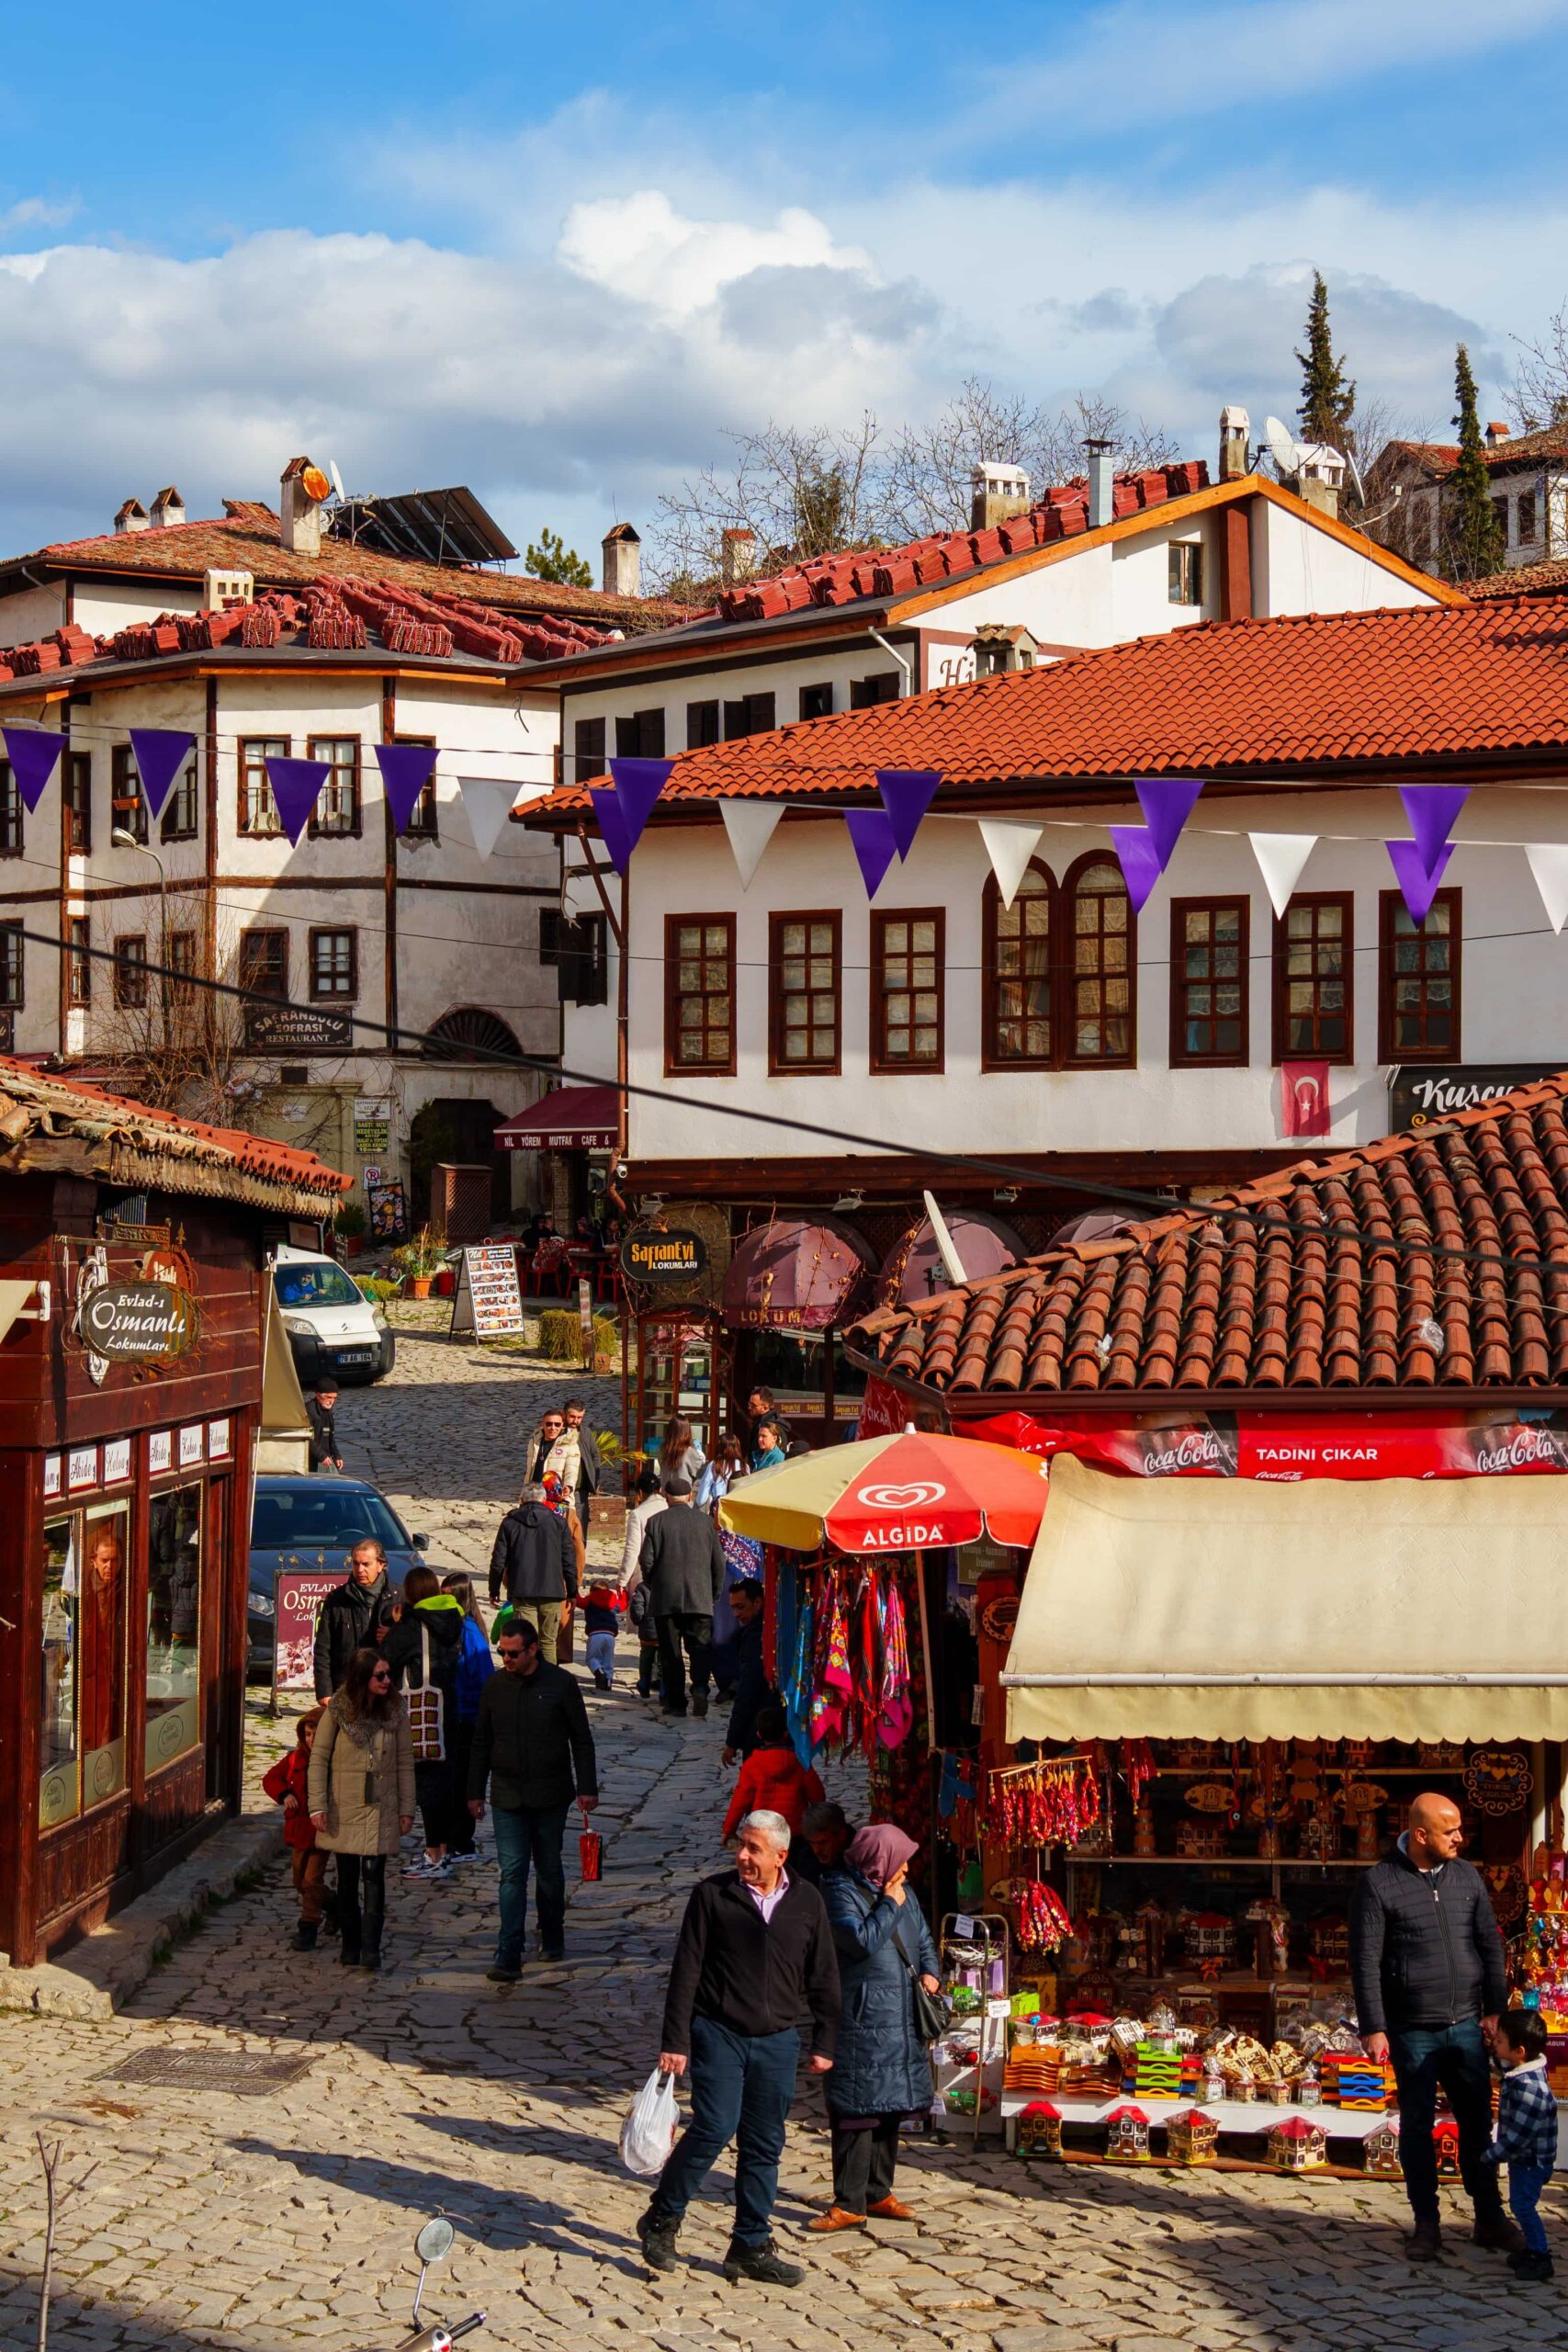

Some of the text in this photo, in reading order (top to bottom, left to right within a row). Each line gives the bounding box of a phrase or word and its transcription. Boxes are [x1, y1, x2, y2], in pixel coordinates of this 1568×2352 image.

[265, 1034, 330, 1043] RESTAURANT
[521, 1135, 541, 1147] YÖREM
[548, 1136, 572, 1146] MUTFAK
[581, 1136, 597, 1146] CAFE
[92, 1302, 186, 1333] Osmanlı
[740, 1309, 801, 1324] LOKUM
[105, 1335, 169, 1351] Lokumları
[1256, 1449, 1378, 1462] TADINI ÇIKAR
